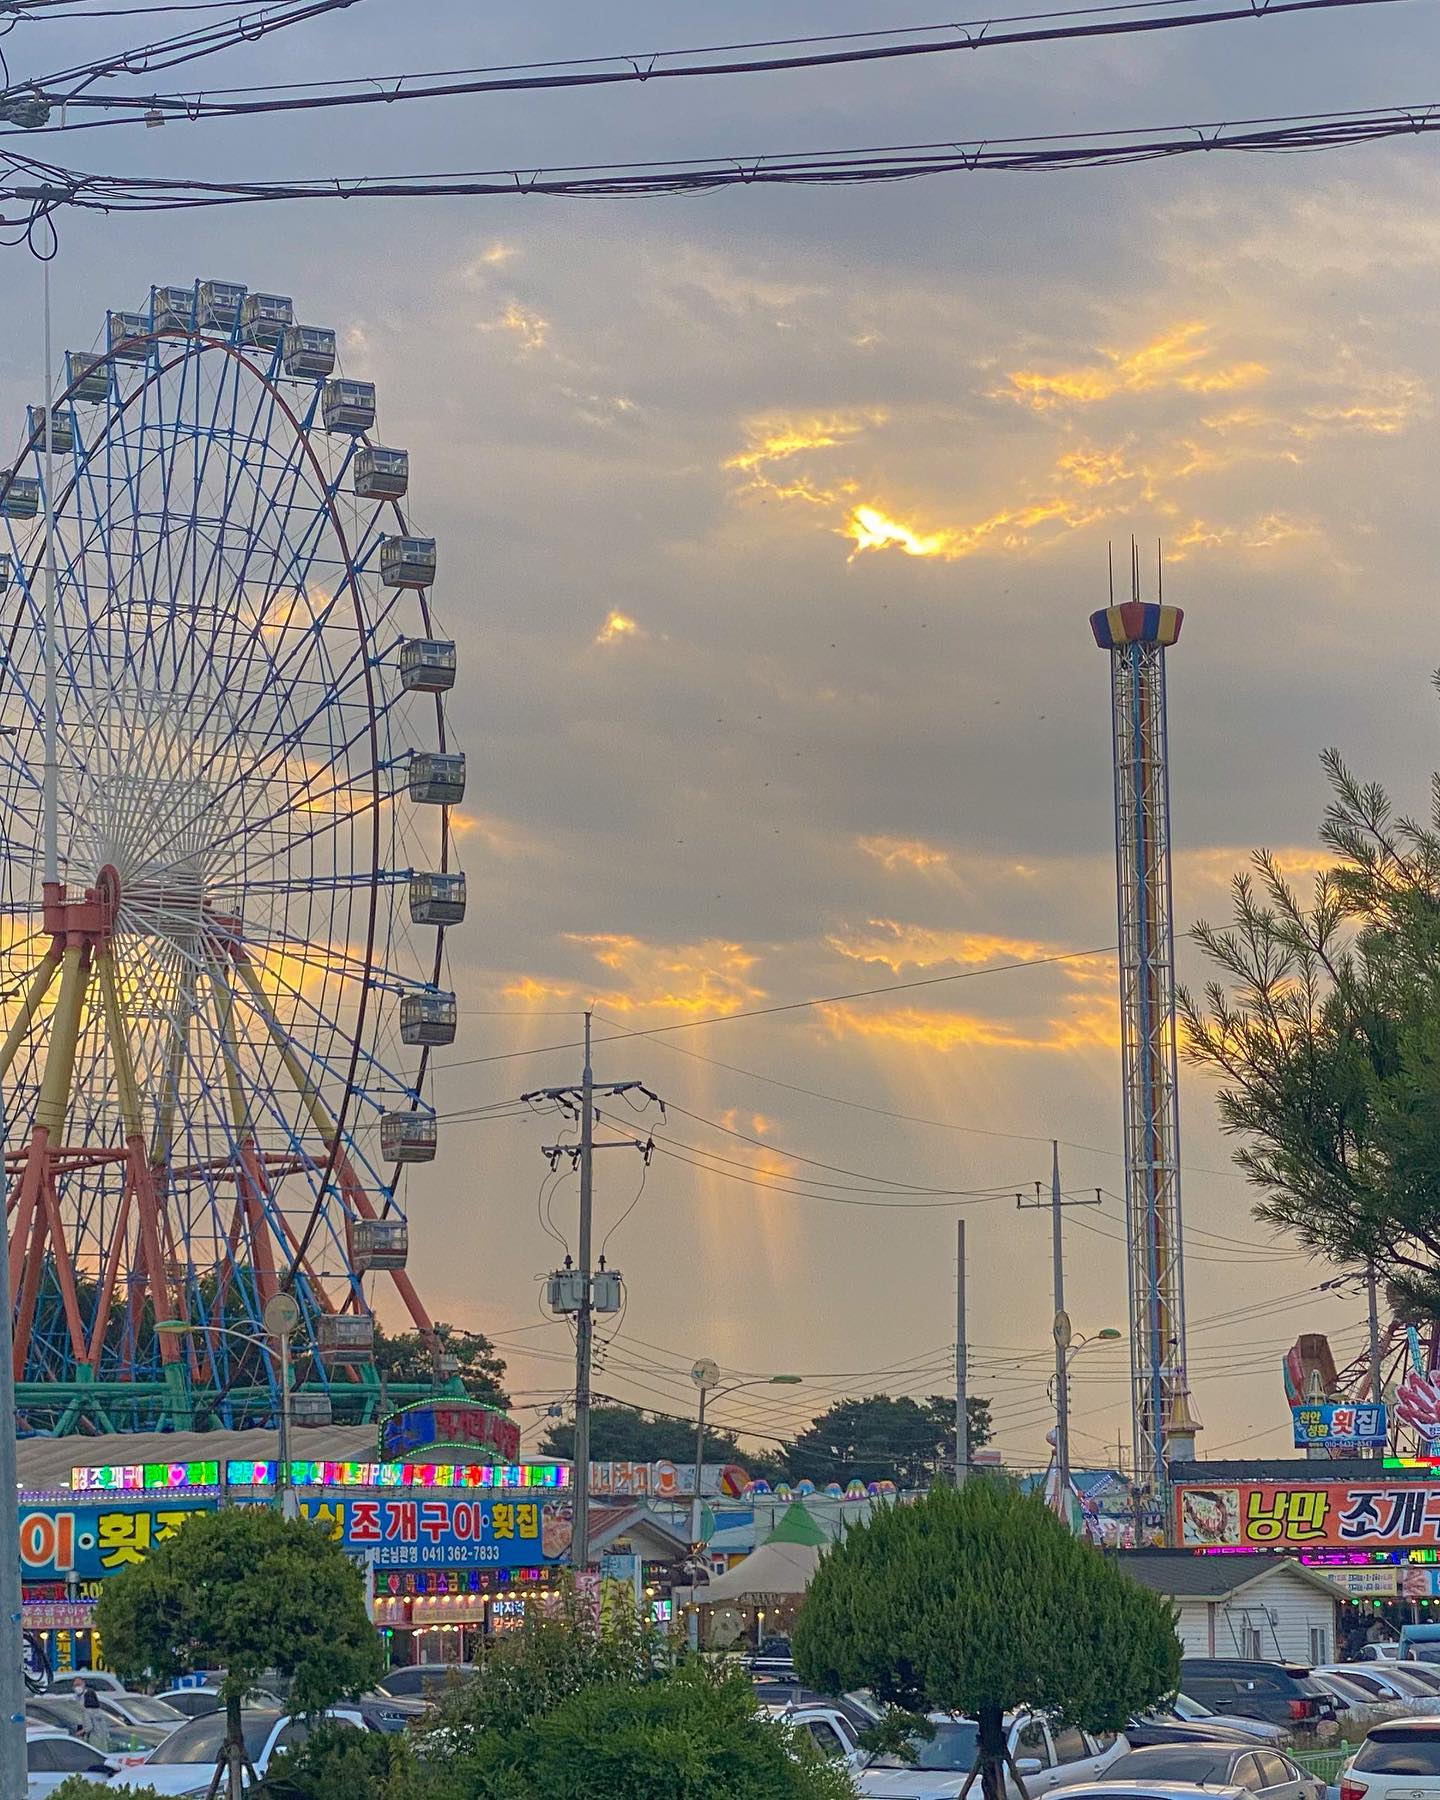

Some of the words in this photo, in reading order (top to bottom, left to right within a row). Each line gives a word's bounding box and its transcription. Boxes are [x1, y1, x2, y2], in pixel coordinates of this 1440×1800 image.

[1300, 1410, 1321, 1424] 천안
[1332, 1409, 1379, 1437] 횟집
[1247, 1490, 1331, 1542] 낭만
[447, 1545, 499, 1562] 362-7833
[493, 1600, 525, 1616] 바지락
